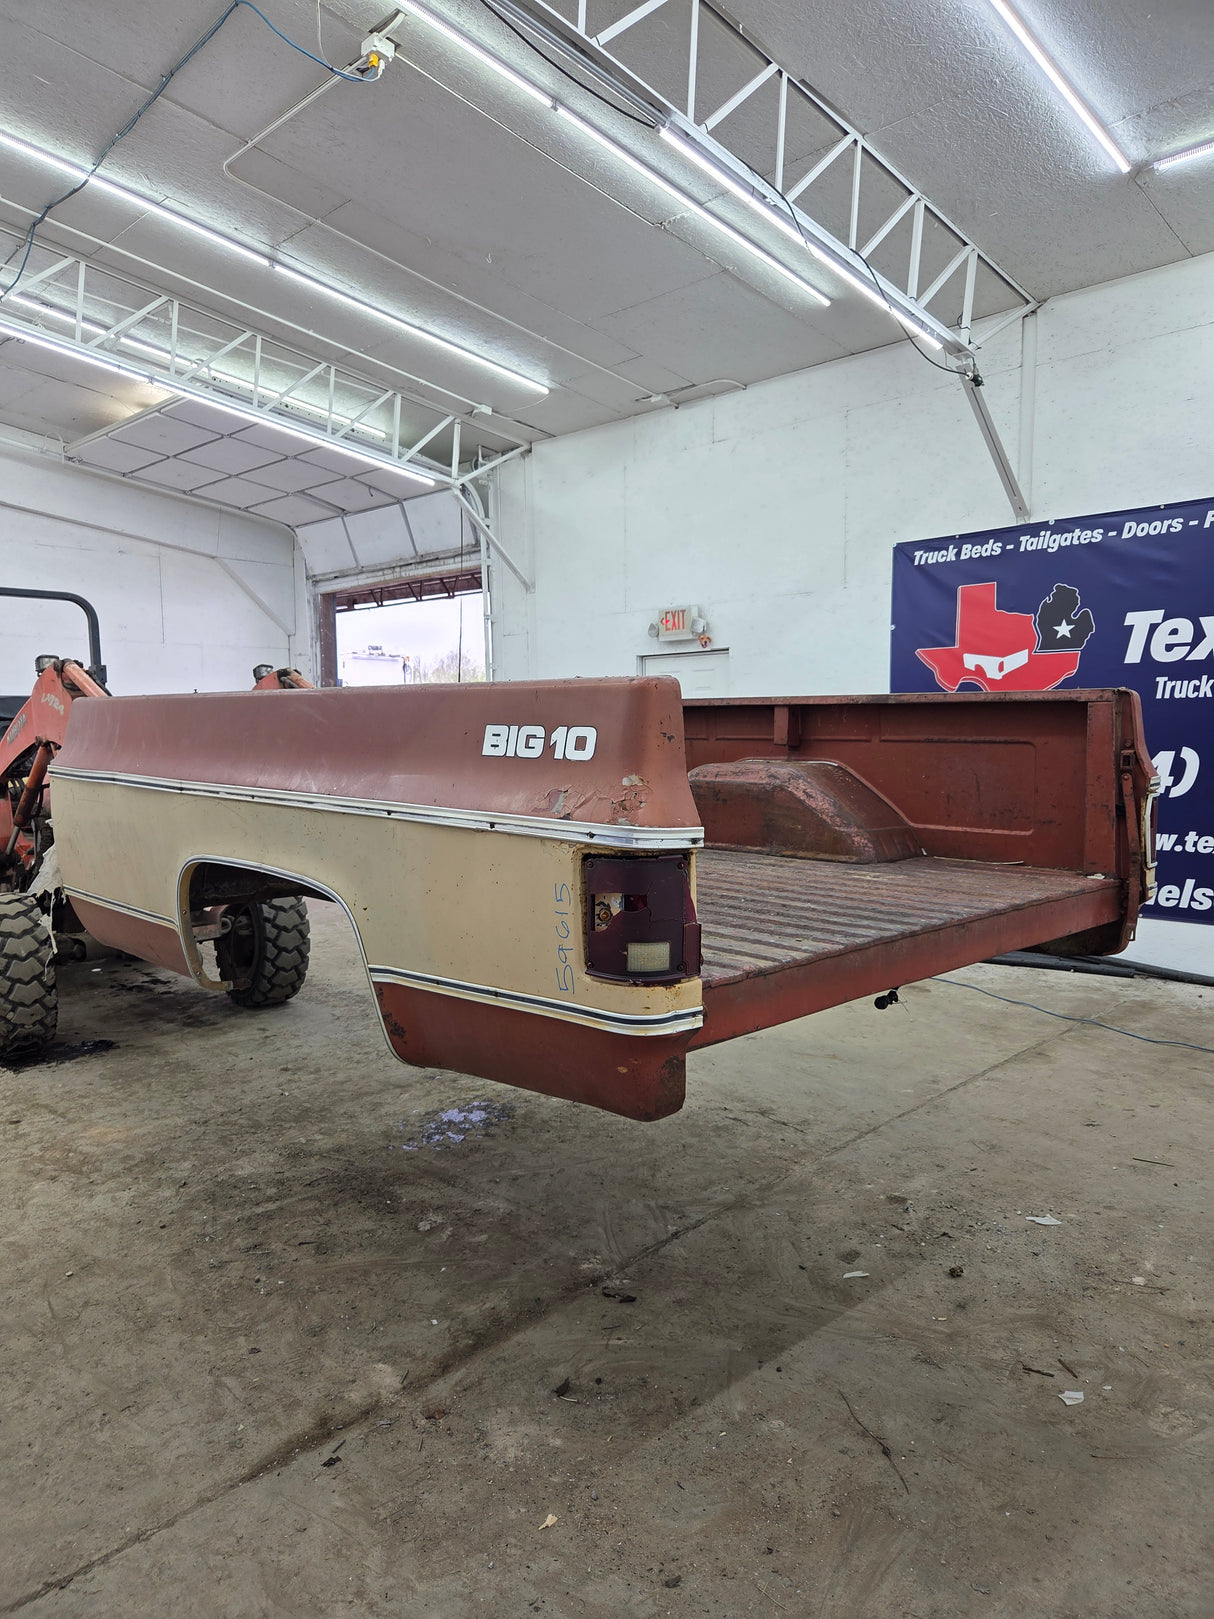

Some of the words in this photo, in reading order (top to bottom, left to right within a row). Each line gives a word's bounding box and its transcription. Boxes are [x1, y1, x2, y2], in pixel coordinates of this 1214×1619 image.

[913, 545, 957, 566] Truck
[960, 539, 1003, 560] Beds
[1019, 528, 1104, 553] Tailgates
[1121, 517, 1184, 539] Doors
[664, 609, 687, 632] EXIT
[1155, 674, 1214, 699] Truck
[481, 724, 547, 759] BIG
[549, 726, 598, 761] 10
[1155, 831, 1214, 854] w.te
[553, 882, 576, 995] 59615
